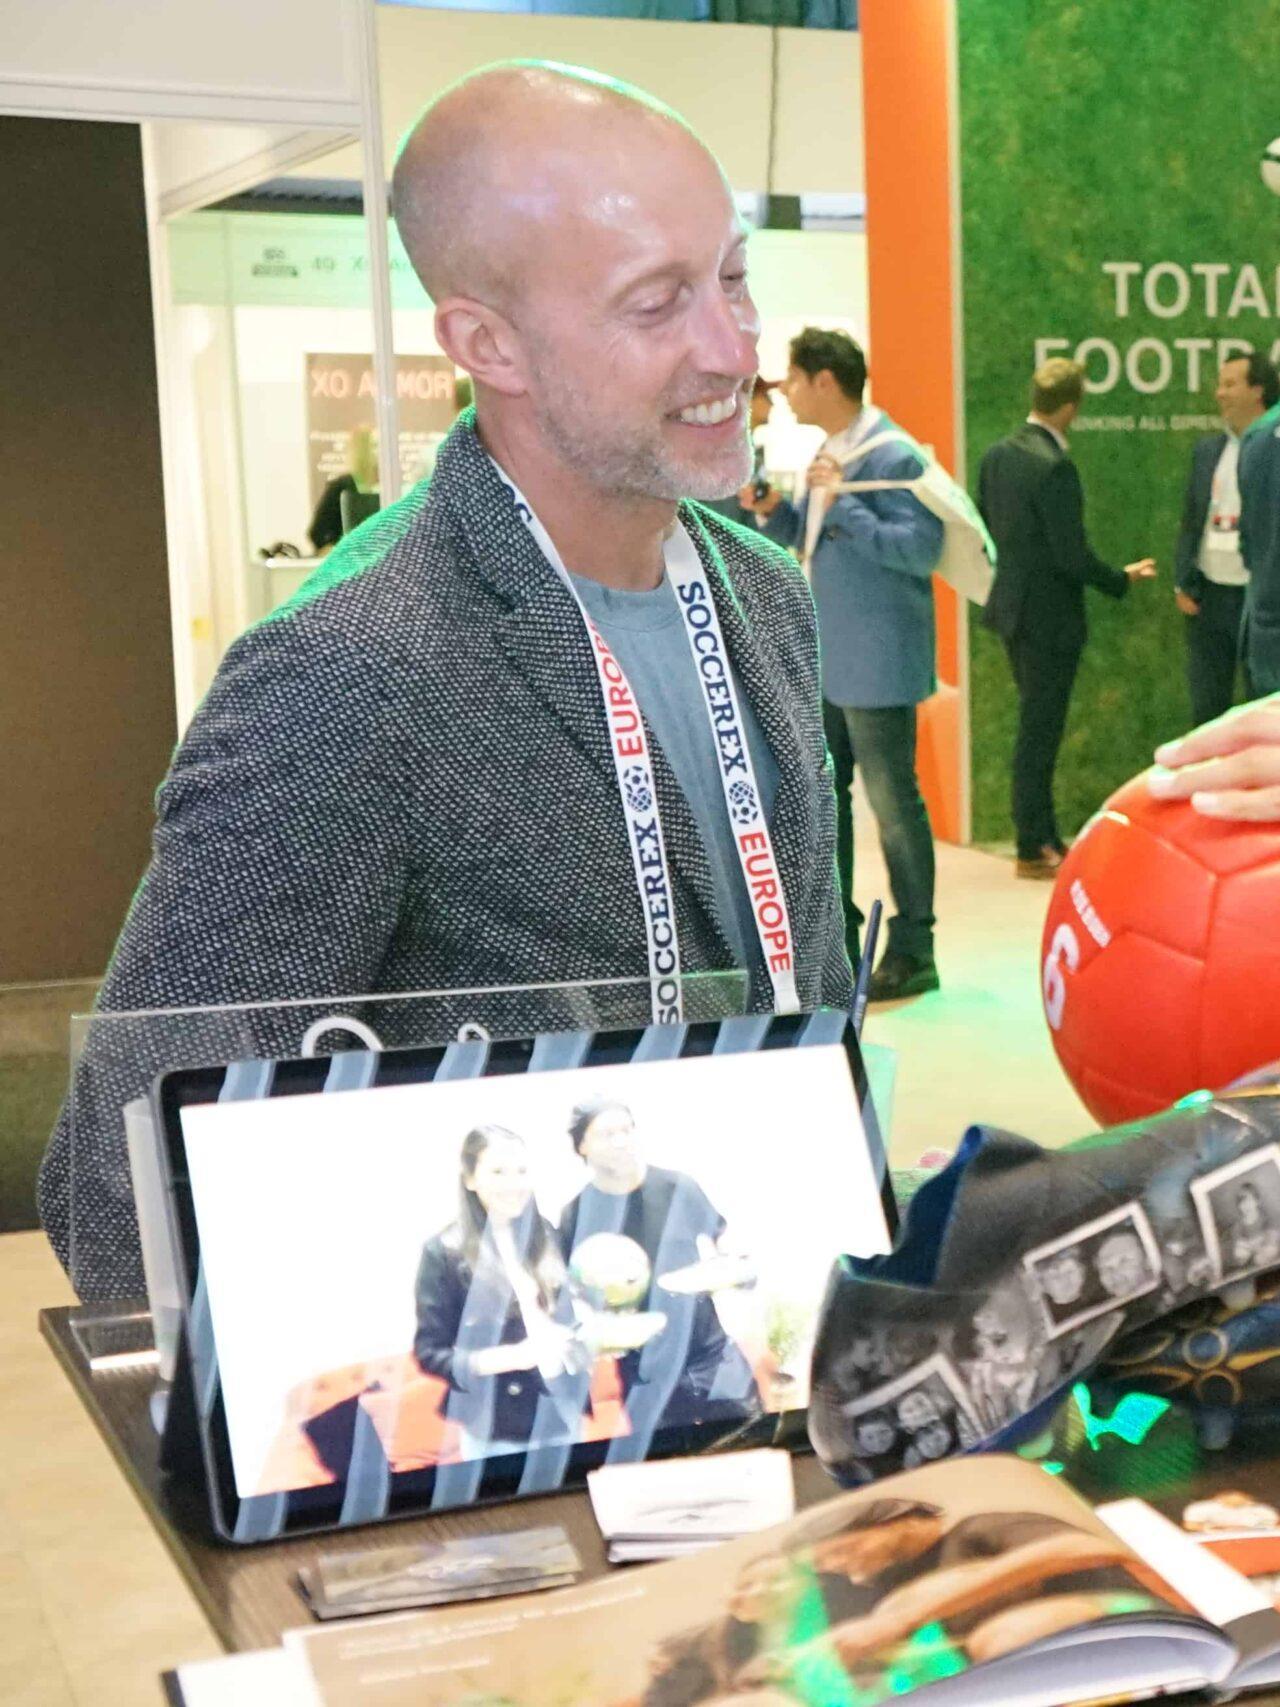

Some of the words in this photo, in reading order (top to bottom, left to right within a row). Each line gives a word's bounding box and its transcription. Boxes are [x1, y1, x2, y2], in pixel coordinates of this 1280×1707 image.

[311, 368, 348, 398] XO
[358, 369, 453, 399] AMOR
[677, 581, 747, 776] SOCCEREX
[633, 817, 679, 1024] SOCCEREX
[739, 831, 790, 973] EUROPE
[1043, 923, 1080, 1031] 6
